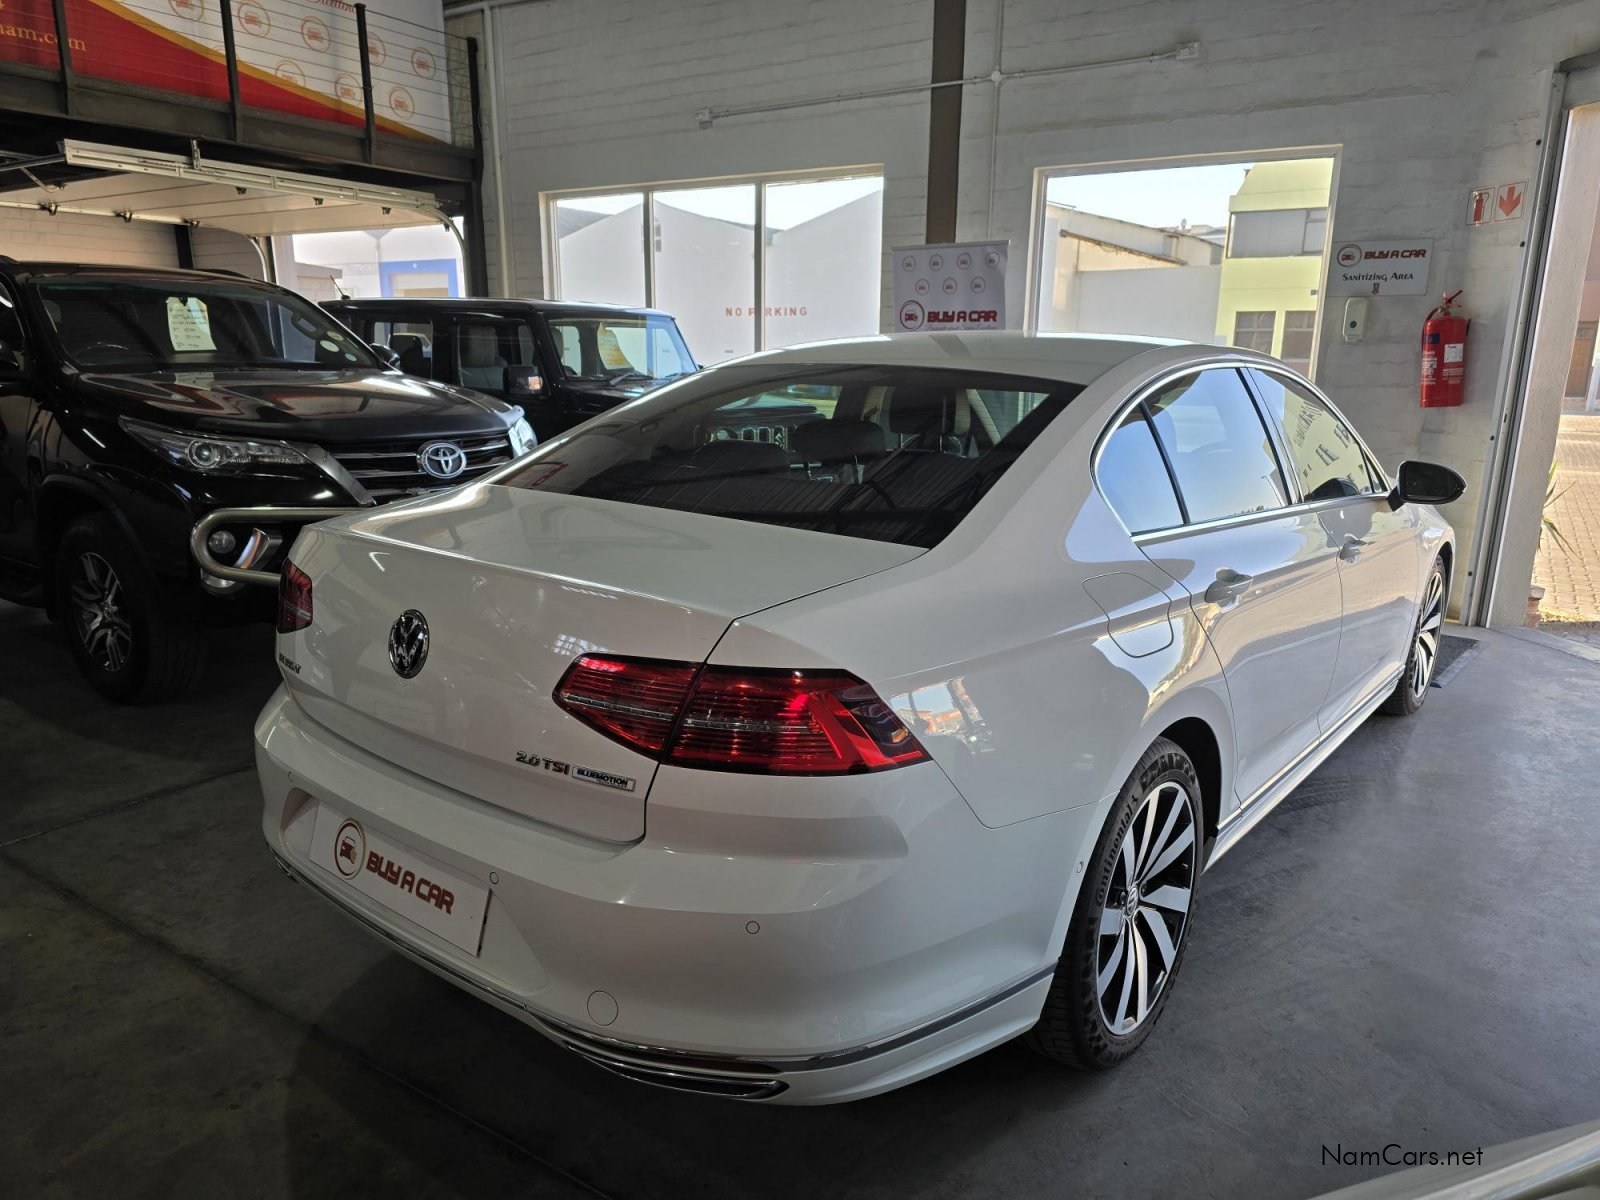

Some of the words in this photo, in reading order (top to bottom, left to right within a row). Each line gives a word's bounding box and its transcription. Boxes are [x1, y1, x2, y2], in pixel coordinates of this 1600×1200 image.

[1363, 250, 1389, 260] BUY
[1390, 250, 1400, 259] A
[1401, 249, 1427, 259] CAR
[725, 307, 742, 317] NO
[748, 306, 807, 317] PRKING
[927, 311, 955, 323] BUY
[956, 311, 967, 323] A
[968, 310, 997, 322] CAR
[542, 758, 570, 775] TSI
[577, 767, 628, 787] BLUEMOTION
[1096, 803, 1137, 906] Continental
[366, 850, 402, 886] BUY
[399, 870, 416, 894] A
[415, 877, 455, 916] CAR
